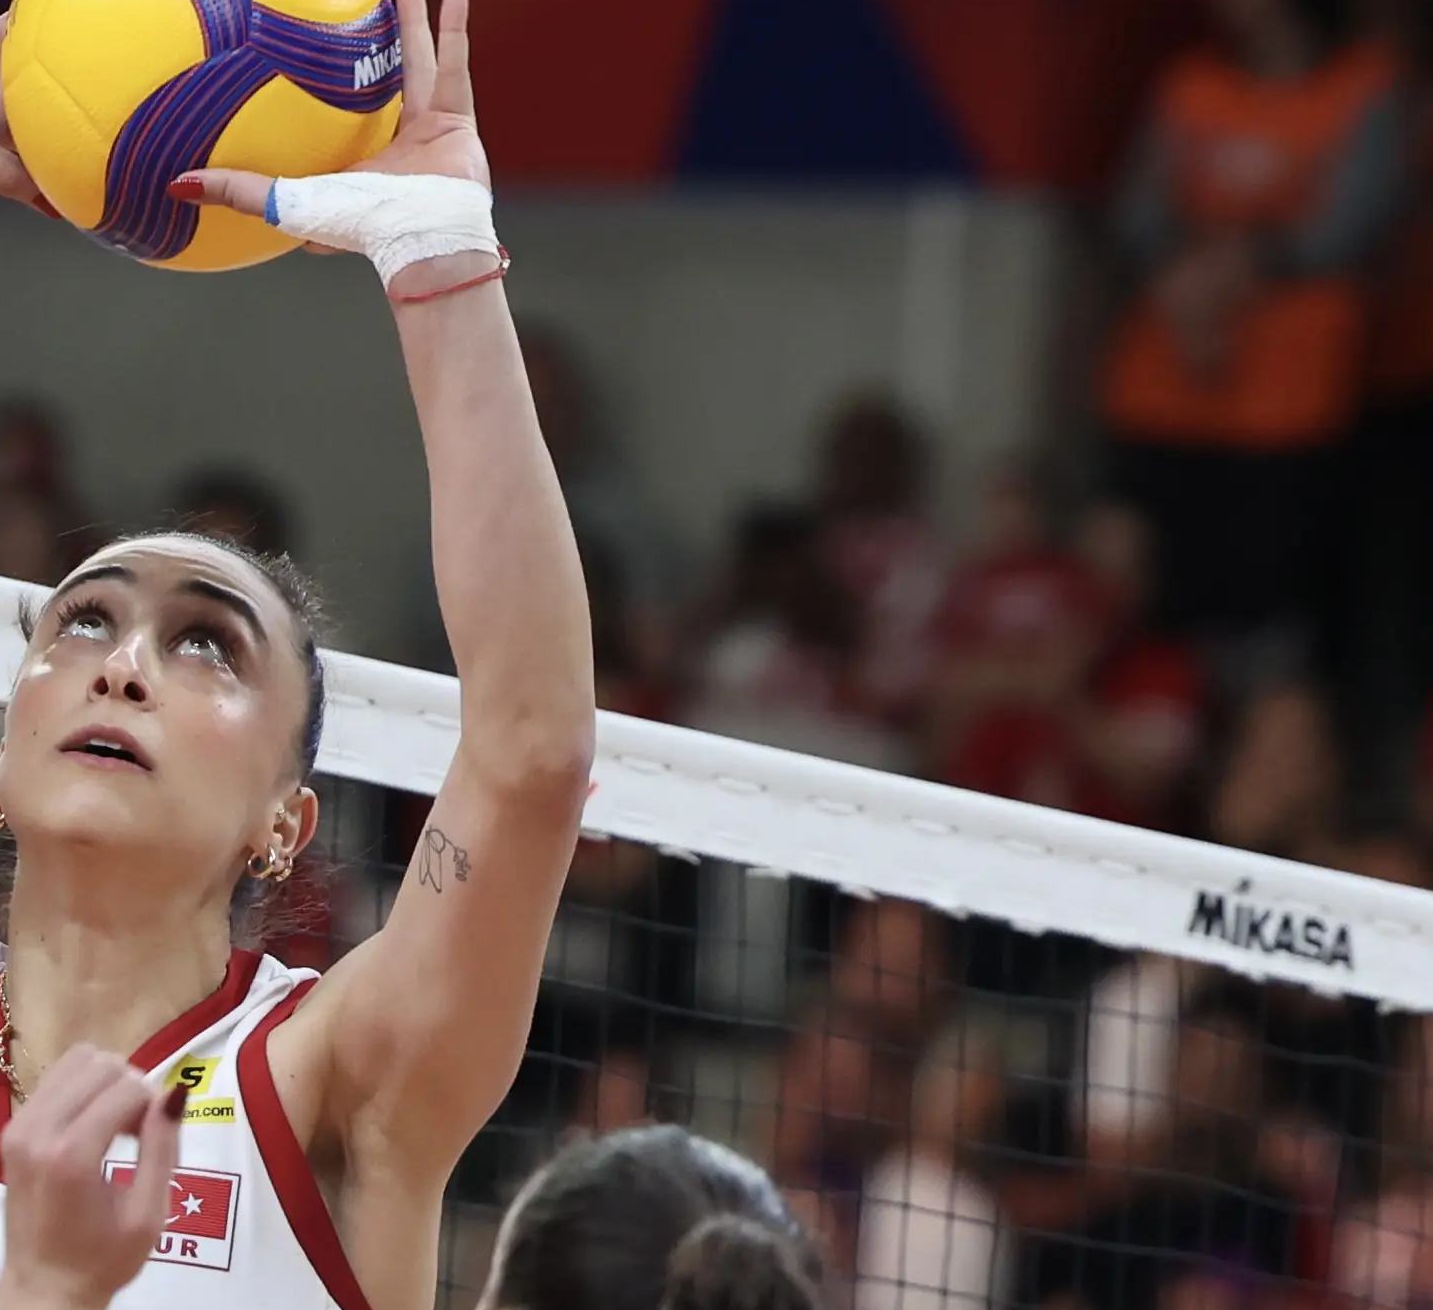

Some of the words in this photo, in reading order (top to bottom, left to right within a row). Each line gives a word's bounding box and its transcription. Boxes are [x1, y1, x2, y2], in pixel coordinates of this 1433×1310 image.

[354, 38, 402, 91] MIKAS
[1188, 877, 1354, 970] MIKASA
[153, 1236, 199, 1258] UR
